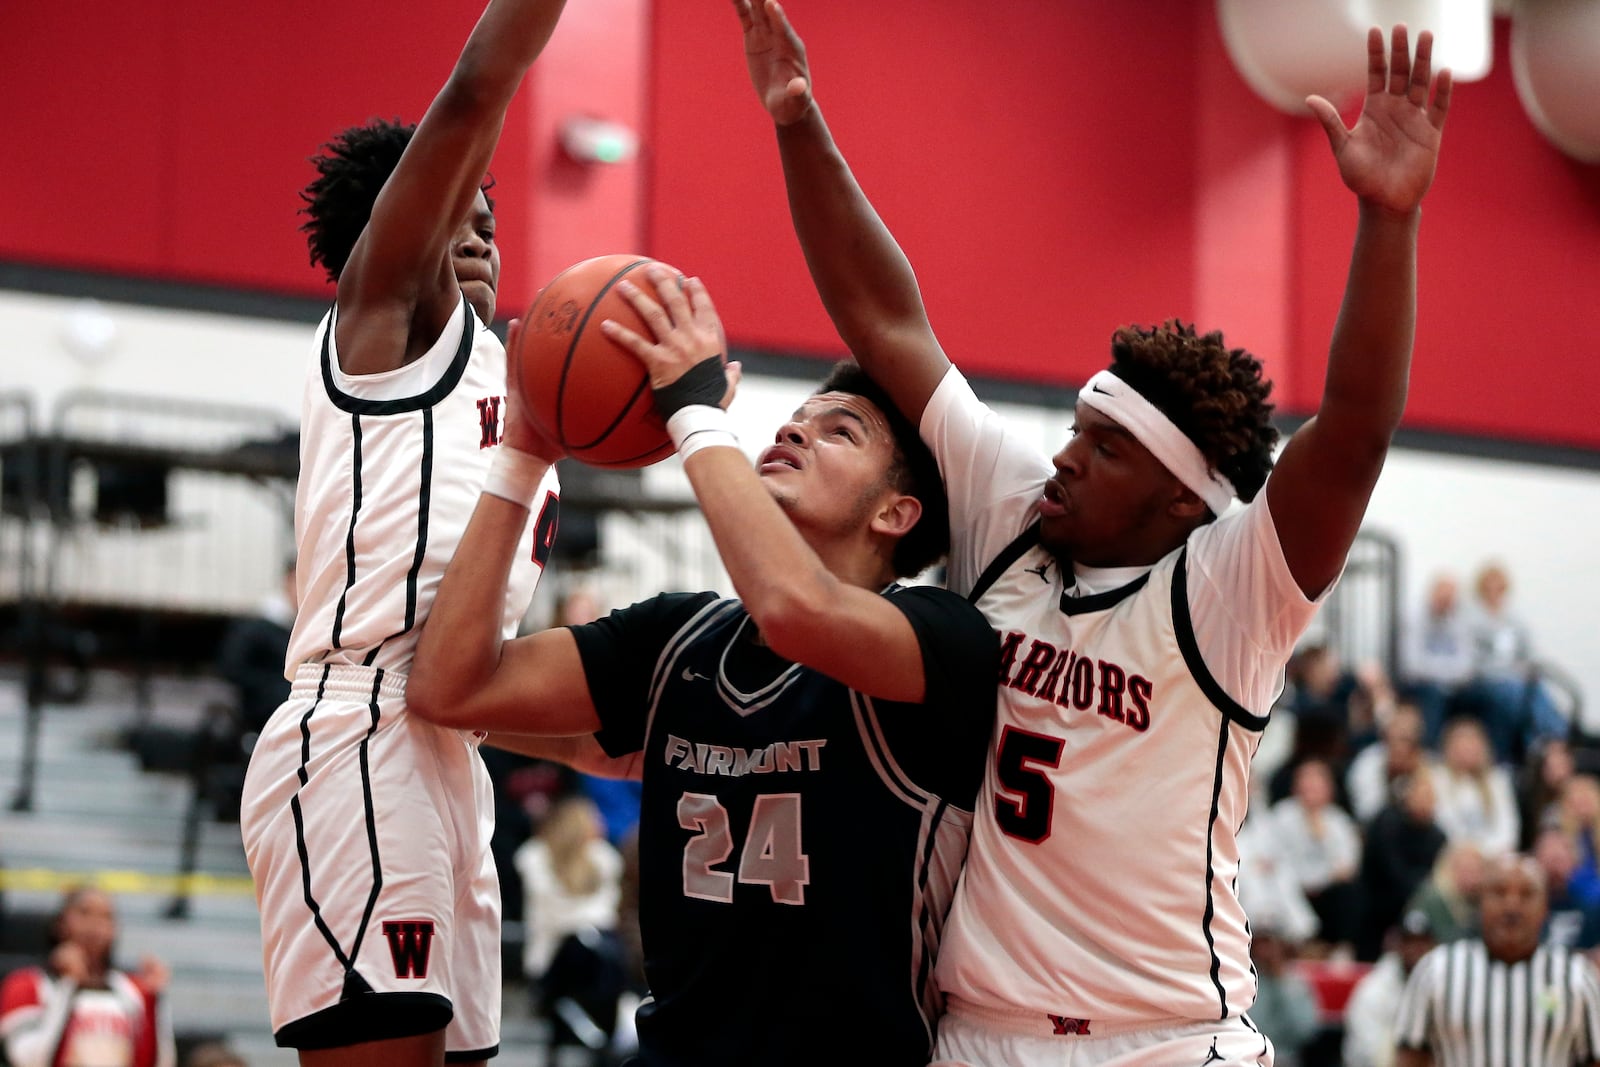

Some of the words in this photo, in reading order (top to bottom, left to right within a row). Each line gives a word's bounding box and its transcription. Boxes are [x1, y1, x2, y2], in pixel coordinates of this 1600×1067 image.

[996, 629, 1153, 732] ARRIORS
[664, 734, 828, 777] FAIRMONT
[995, 724, 1066, 845] 5
[677, 791, 810, 905] 24
[382, 920, 435, 979] W
